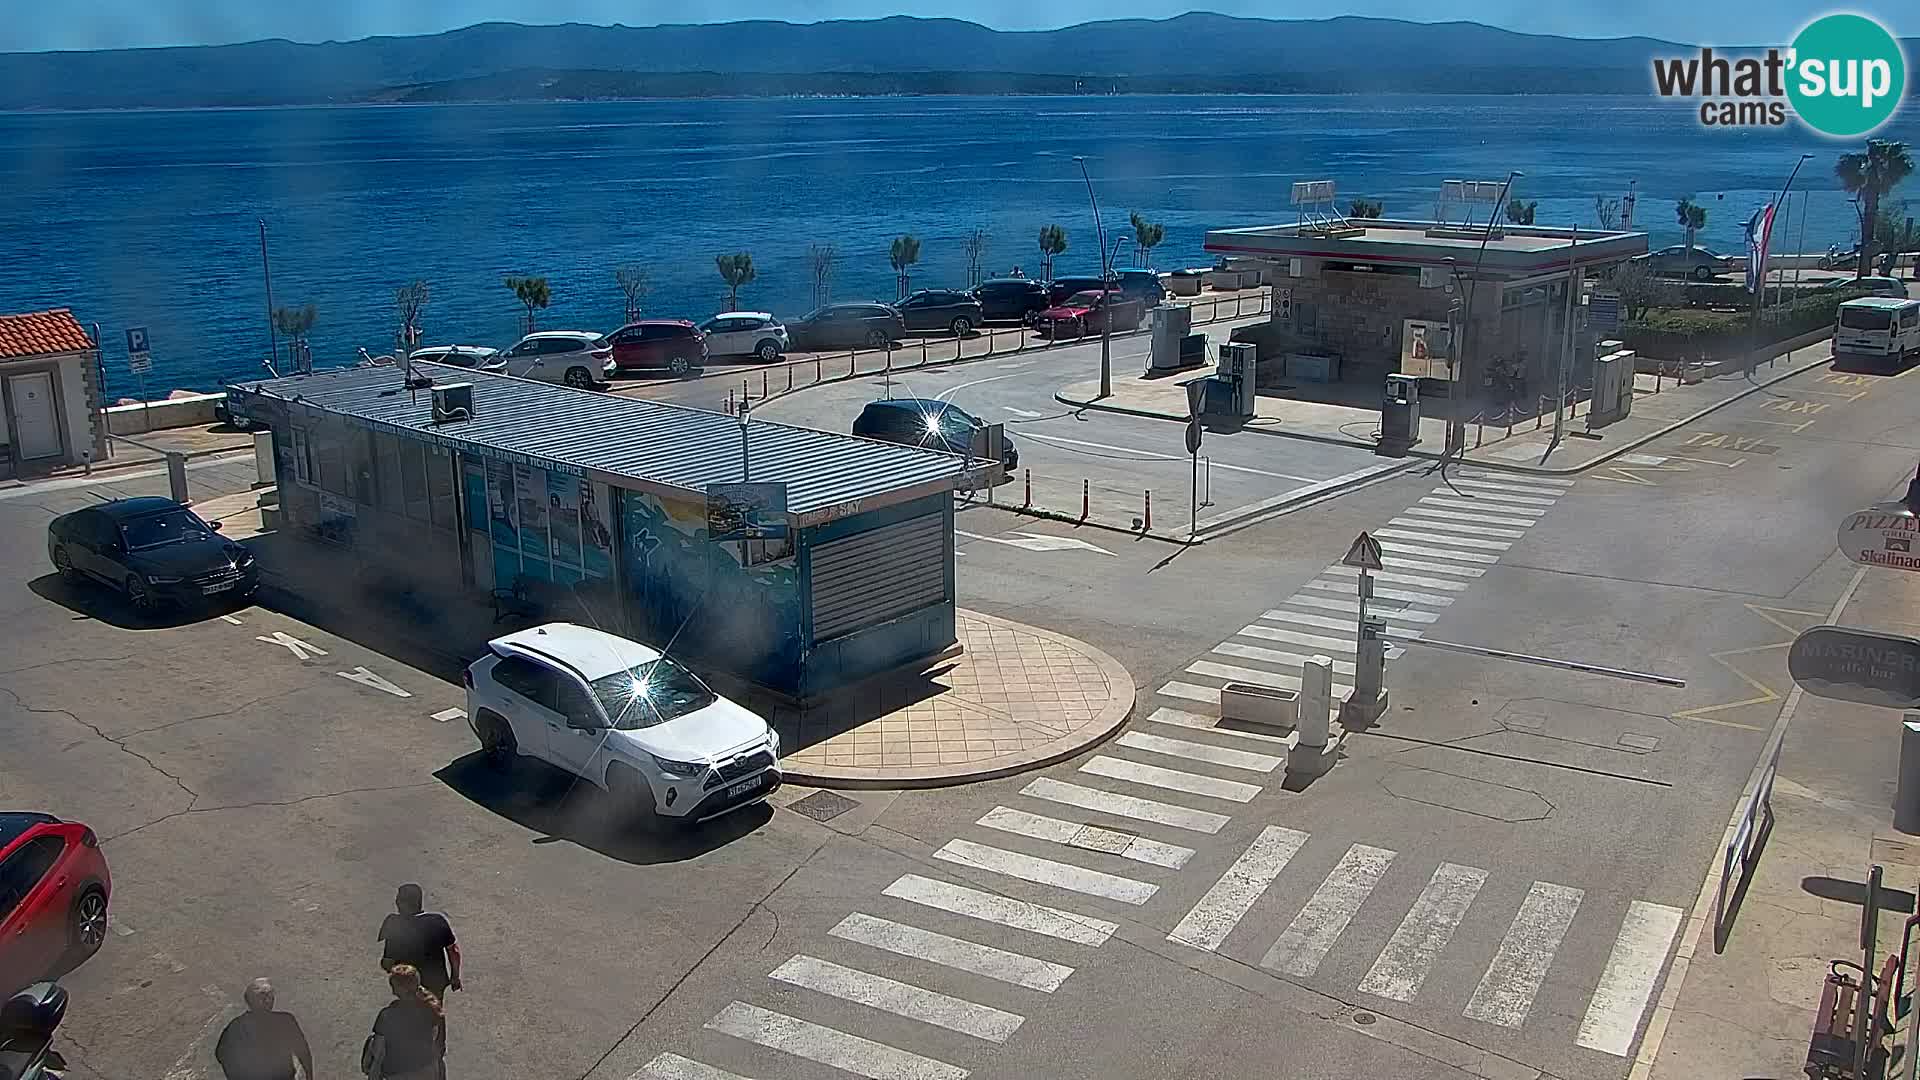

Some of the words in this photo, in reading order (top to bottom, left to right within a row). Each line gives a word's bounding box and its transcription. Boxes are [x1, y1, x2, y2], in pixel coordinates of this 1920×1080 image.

[131, 330, 144, 349] P
[1816, 373, 1881, 386] TAXI
[1759, 399, 1830, 414] TAXI
[1686, 432, 1765, 451] TAXI
[495, 449, 527, 465] STATION
[528, 457, 554, 471] TICKET
[555, 463, 583, 477] OFFICE
[1848, 515, 1920, 533] PIZZE
[1801, 643, 1920, 672] MARINER
[1870, 664, 1897, 680] bar
